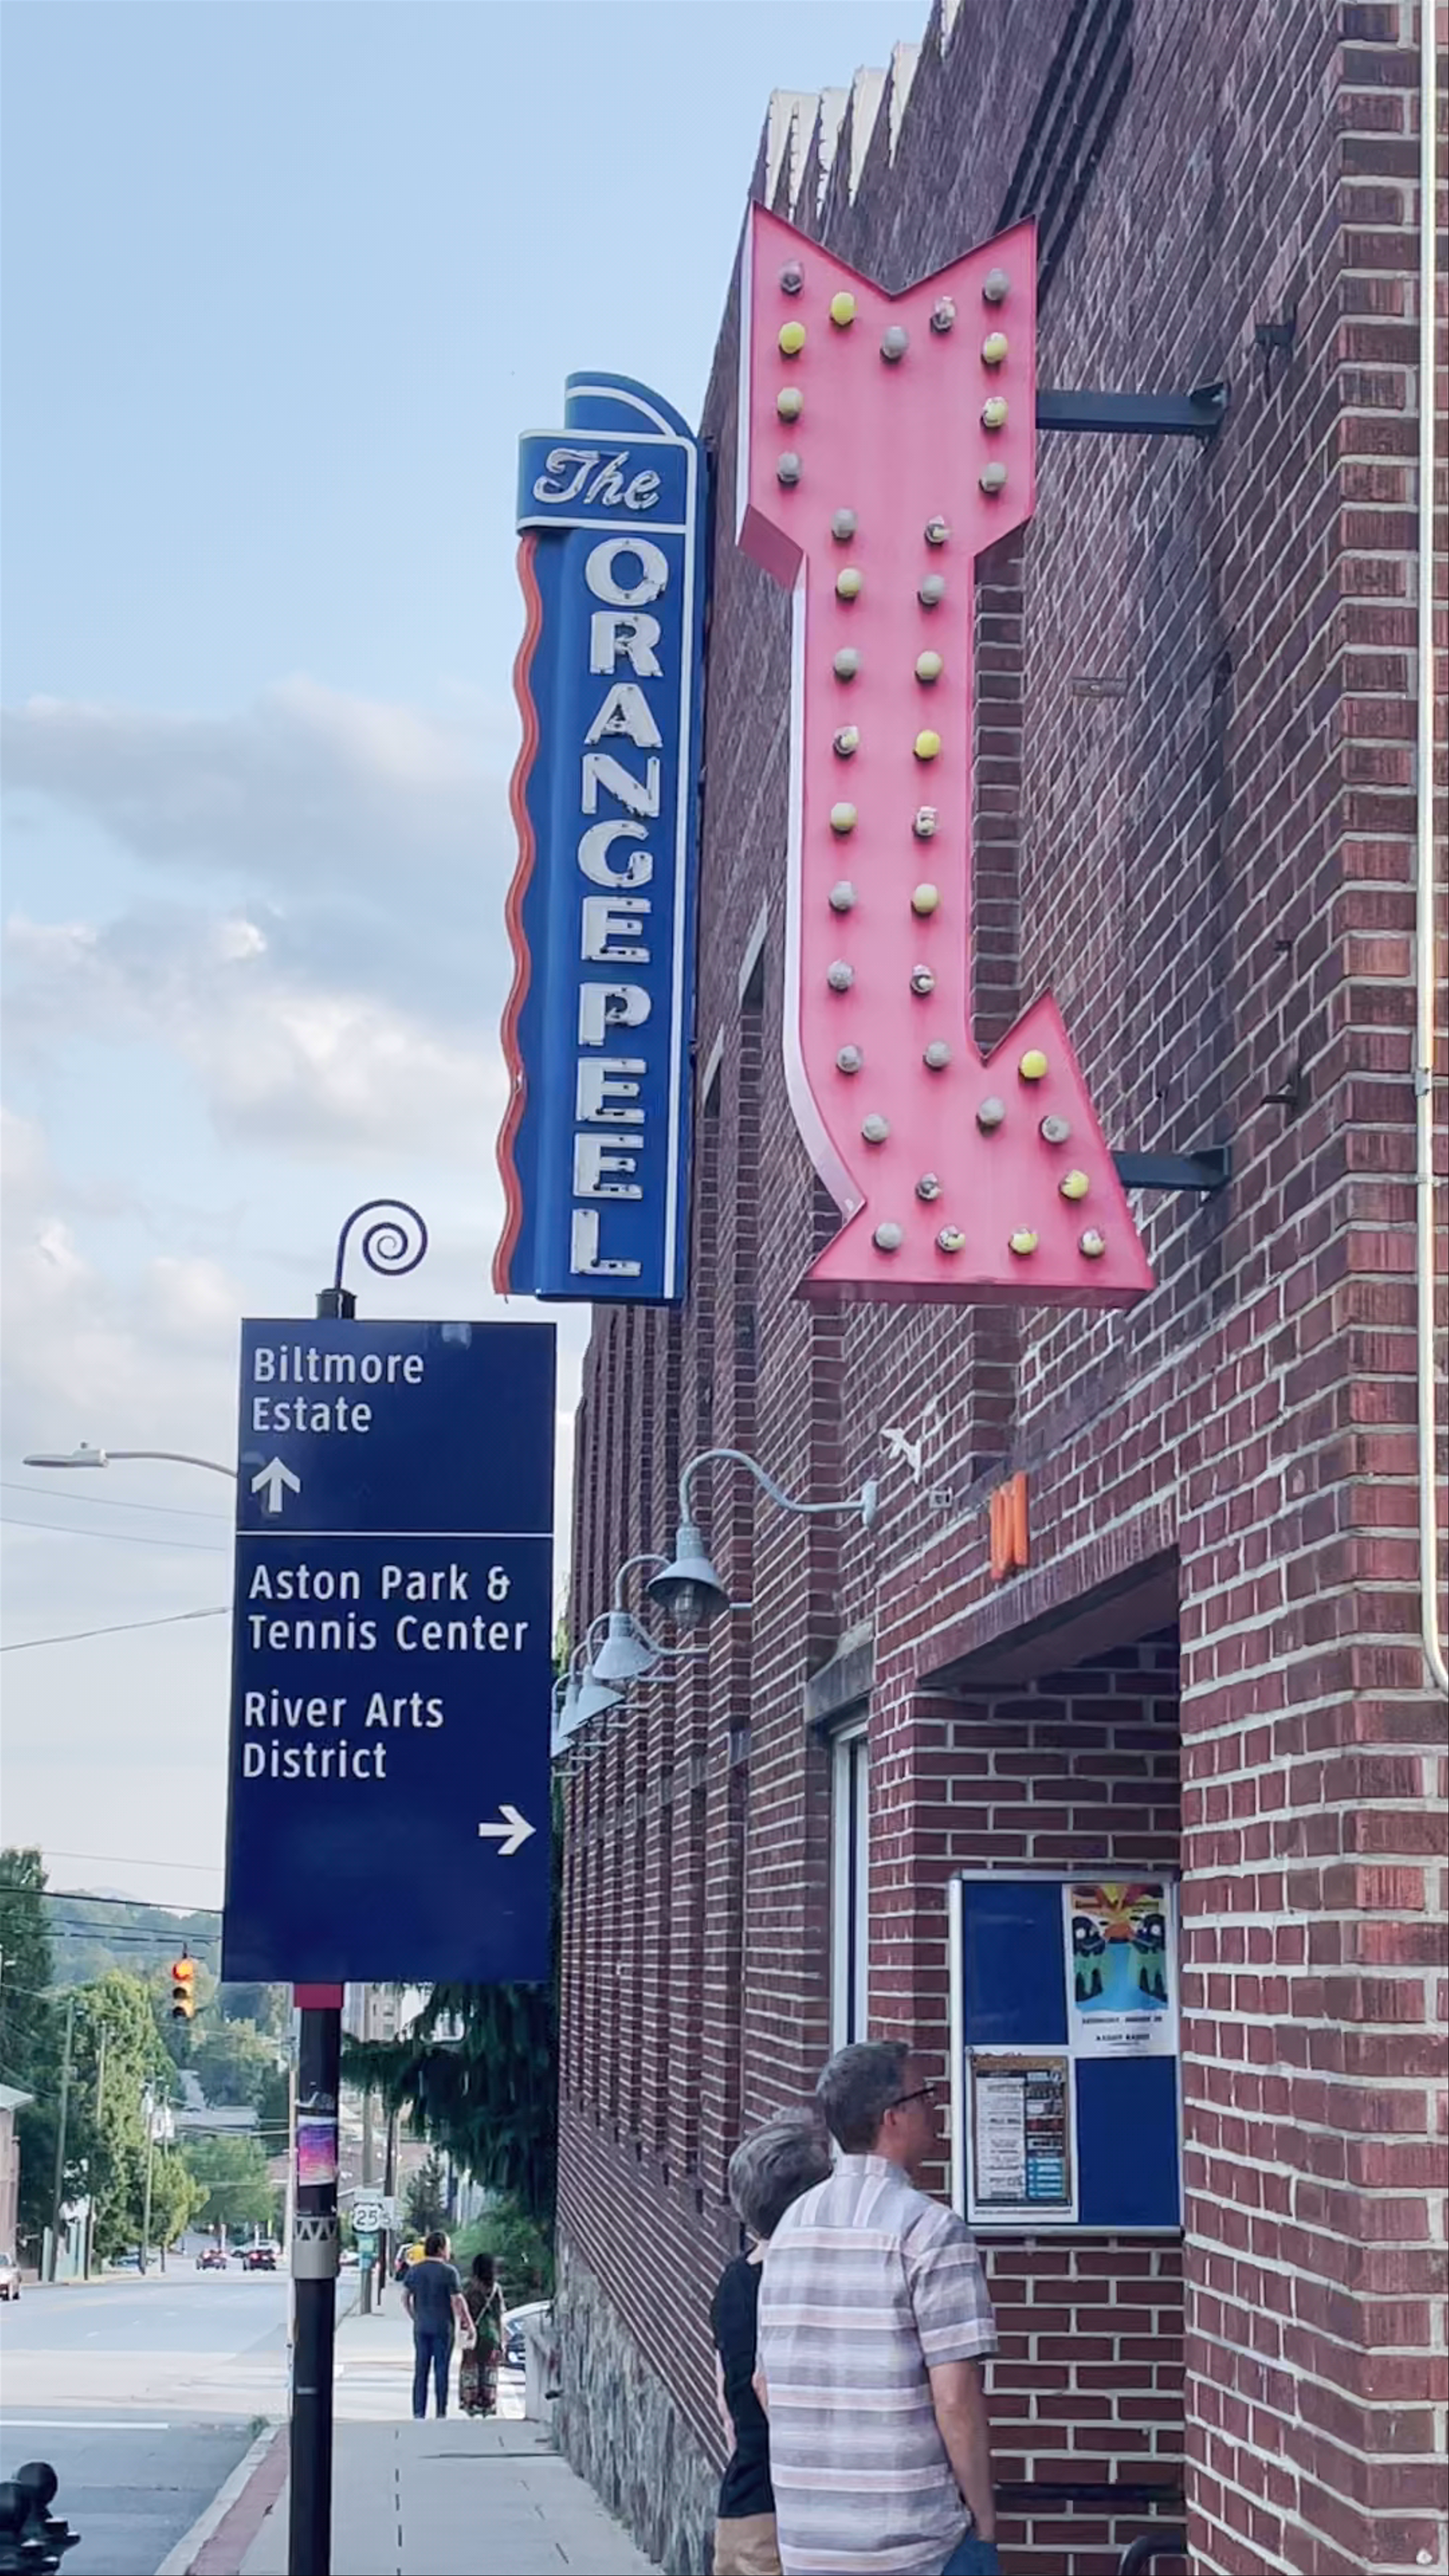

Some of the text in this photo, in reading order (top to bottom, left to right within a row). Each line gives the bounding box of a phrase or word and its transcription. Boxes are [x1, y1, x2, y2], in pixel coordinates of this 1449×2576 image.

[533, 448, 661, 509] The
[577, 537, 669, 963] ORANGE
[570, 983, 651, 1276] PEEL
[254, 1345, 424, 1384] Biltmore
[253, 1396, 372, 1432] Estate
[249, 1564, 511, 1601] Aston Park &
[249, 1612, 528, 1650] Tennis Center
[245, 1689, 443, 1728] River Arts
[243, 1739, 387, 1778] District
[357, 2210, 377, 2225] 25
